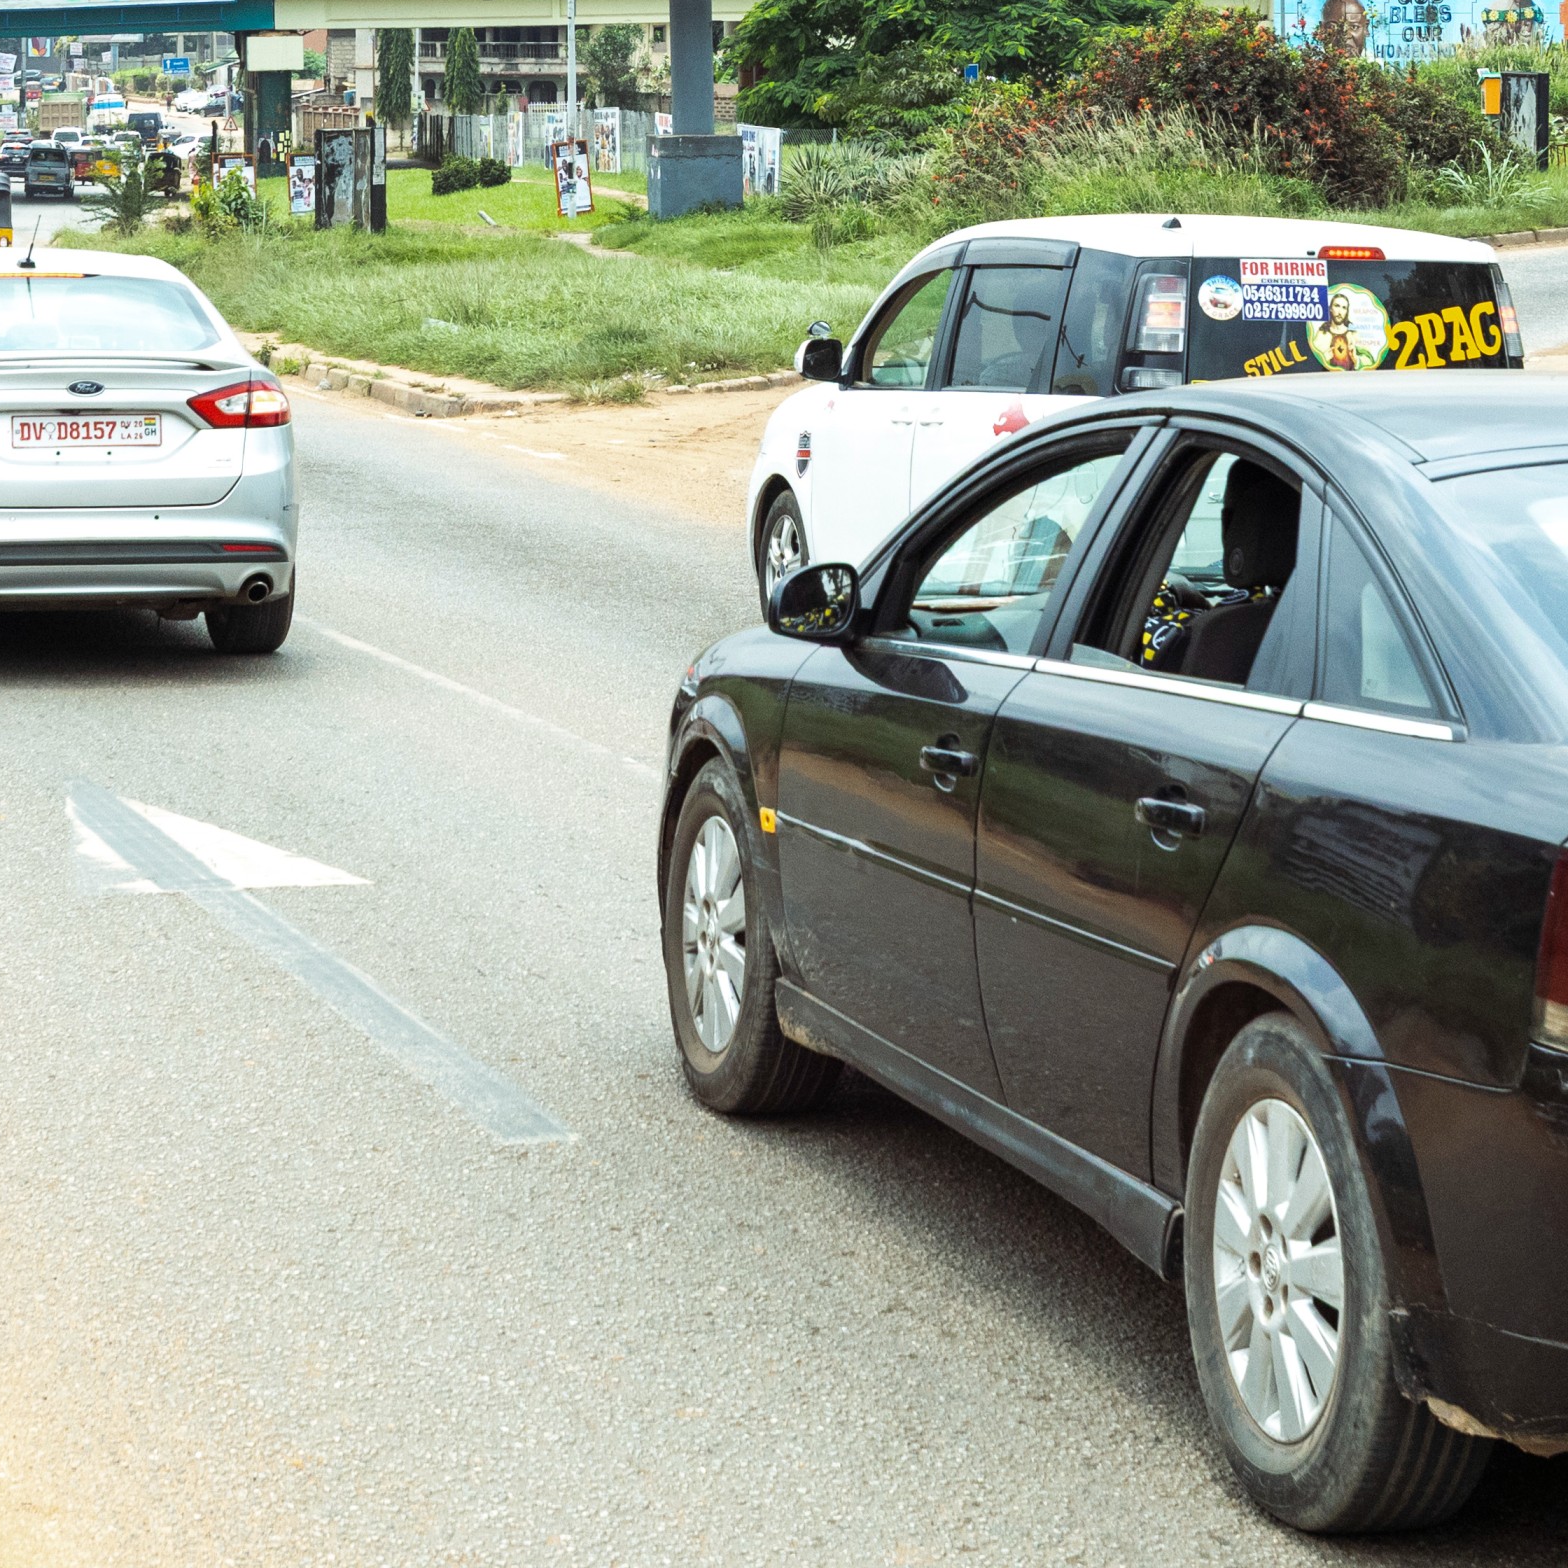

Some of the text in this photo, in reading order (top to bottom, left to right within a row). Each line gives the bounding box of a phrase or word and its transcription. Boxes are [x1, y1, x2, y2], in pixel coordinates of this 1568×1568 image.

[1402, 24, 1443, 43] OUR
[1241, 261, 1326, 277] FOR HIRING
[1243, 284, 1319, 303] 0546311724
[1245, 303, 1323, 320] 0257599800
[1387, 301, 1502, 371] 2PAC
[1244, 340, 1308, 378] STILL
[75, 382, 98, 394] Ford
[19, 420, 117, 441] DV D8157
[144, 427, 157, 437] GH
